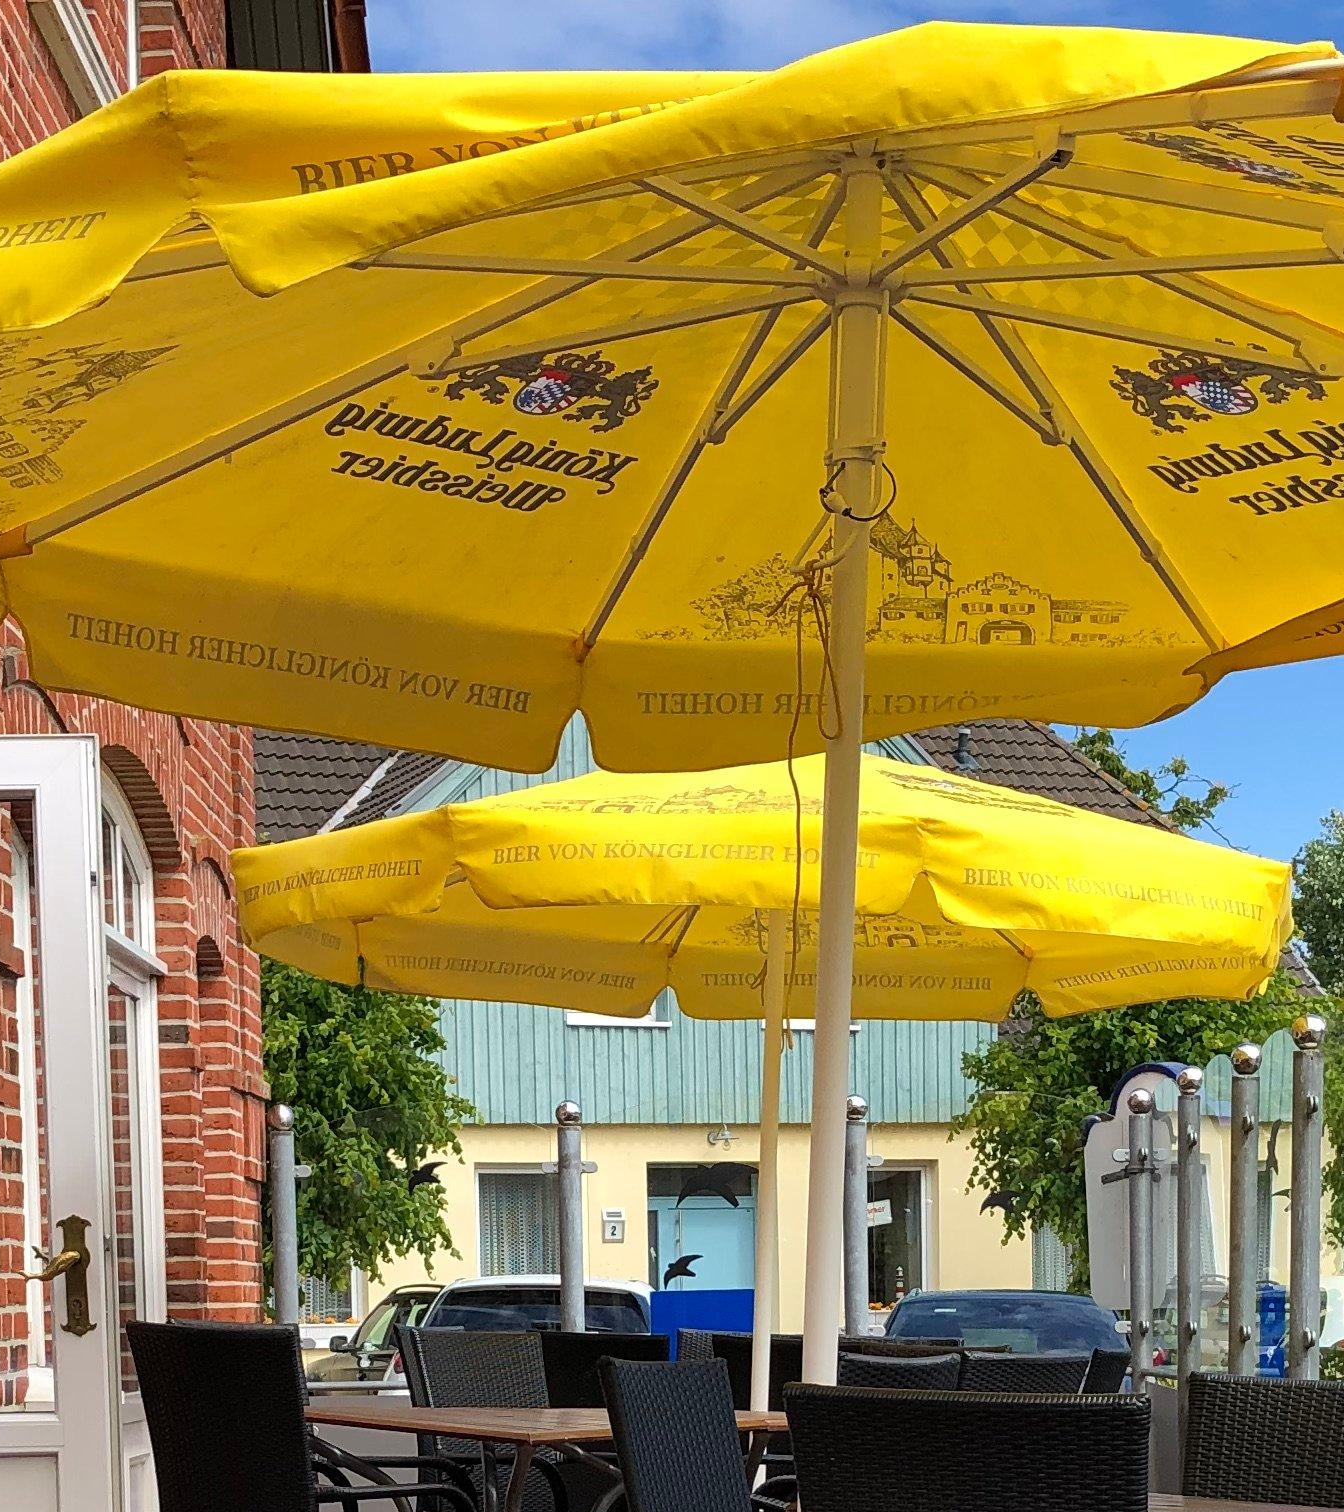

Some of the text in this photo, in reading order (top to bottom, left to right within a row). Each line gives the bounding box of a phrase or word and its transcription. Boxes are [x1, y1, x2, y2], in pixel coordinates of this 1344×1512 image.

[493, 838, 881, 869] BIER VON KÖNIGLICHER HOIT
[283, 865, 364, 891] KÖNIGLICHER
[366, 859, 423, 879] HOHEIT
[963, 867, 1013, 887] BIER
[1018, 871, 1059, 891] VON
[1200, 894, 1265, 922] HOHEIT
[610, 1224, 618, 1237] 2
